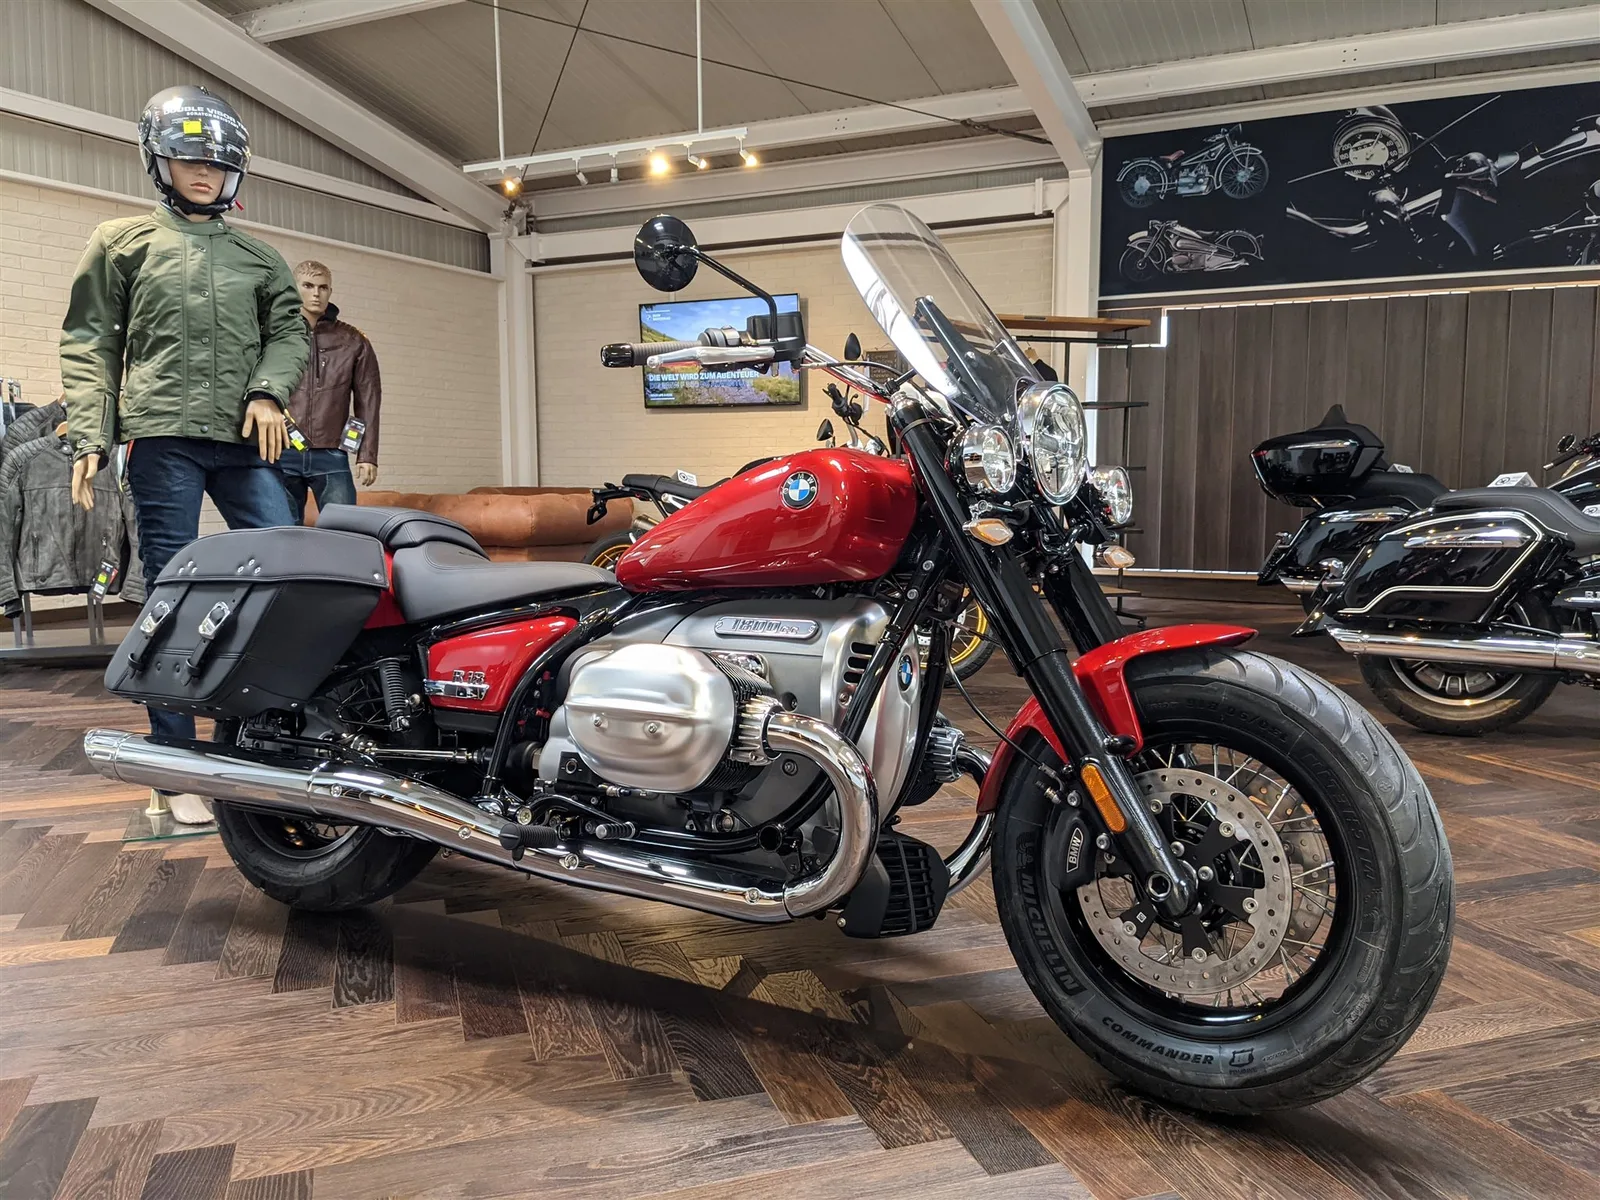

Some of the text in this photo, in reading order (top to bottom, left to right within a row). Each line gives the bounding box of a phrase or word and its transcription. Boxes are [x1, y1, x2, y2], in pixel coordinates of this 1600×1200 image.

[206, 107, 236, 122] VISOR
[649, 373, 660, 381] DIE
[661, 373, 679, 381] WELT
[700, 372, 716, 380] ZUM
[717, 371, 760, 379] ABENTEUER
[1069, 836, 1081, 864] BMW
[1022, 874, 1079, 990] MICHELIN
[1101, 1016, 1214, 1065] COMMANDER
